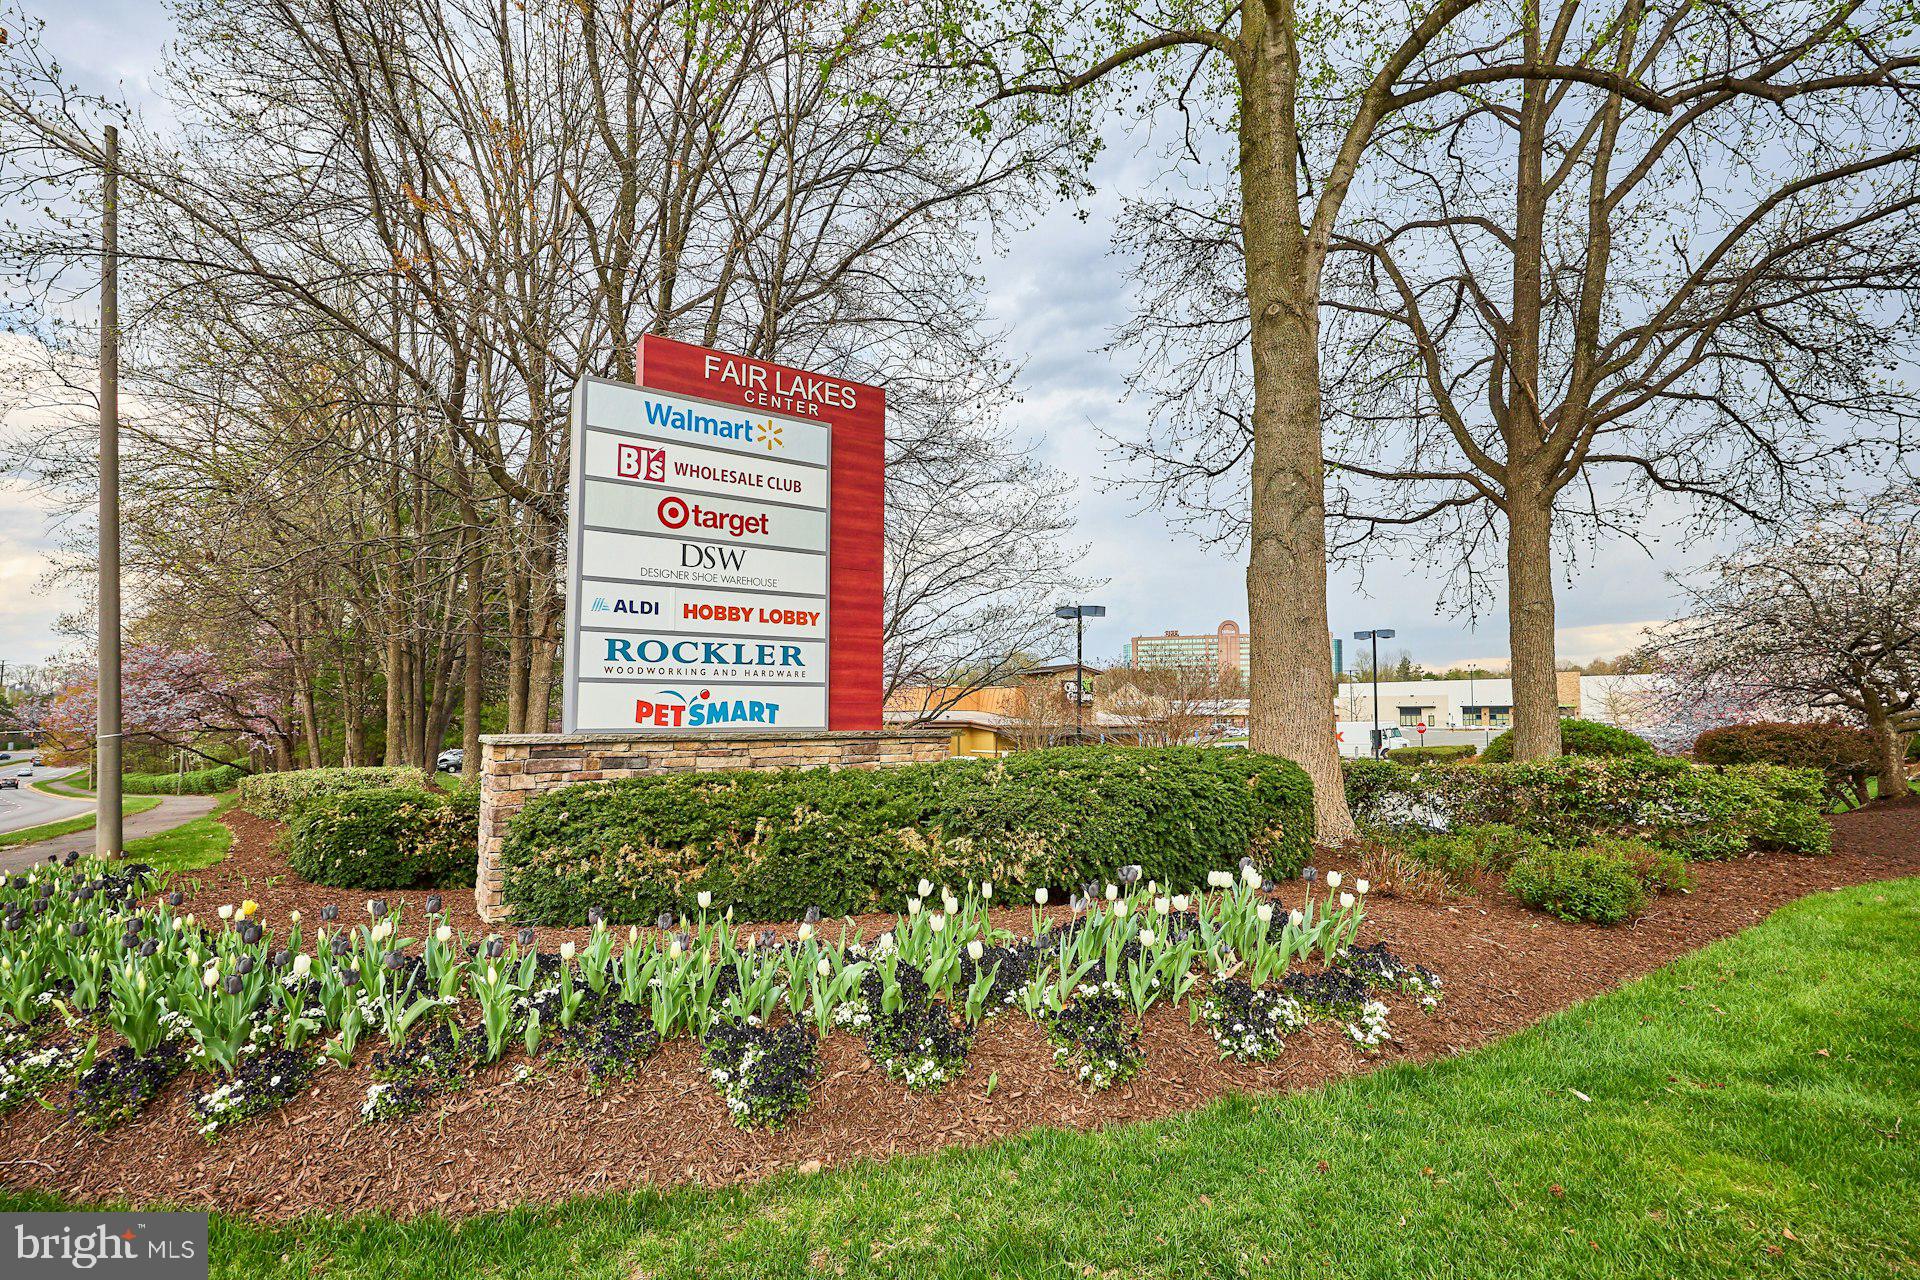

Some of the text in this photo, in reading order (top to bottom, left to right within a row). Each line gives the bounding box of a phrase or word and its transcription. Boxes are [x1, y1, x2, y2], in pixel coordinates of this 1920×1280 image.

[704, 355, 857, 410] FAIR LAKES
[744, 390, 819, 417] CENTER
[644, 401, 753, 442] Walmart
[674, 461, 764, 488] WHOLESALE
[767, 476, 802, 493] CLUB
[692, 504, 769, 537] target
[680, 543, 747, 572] DSW
[640, 567, 778, 588] DESIGNER SHOE WAREHOUSE
[613, 599, 659, 615] ALDI
[683, 603, 820, 627] HOBBY LOBBY
[604, 638, 806, 667] ROCKLER
[604, 666, 806, 678] WOODWORKING AND HARDWARE
